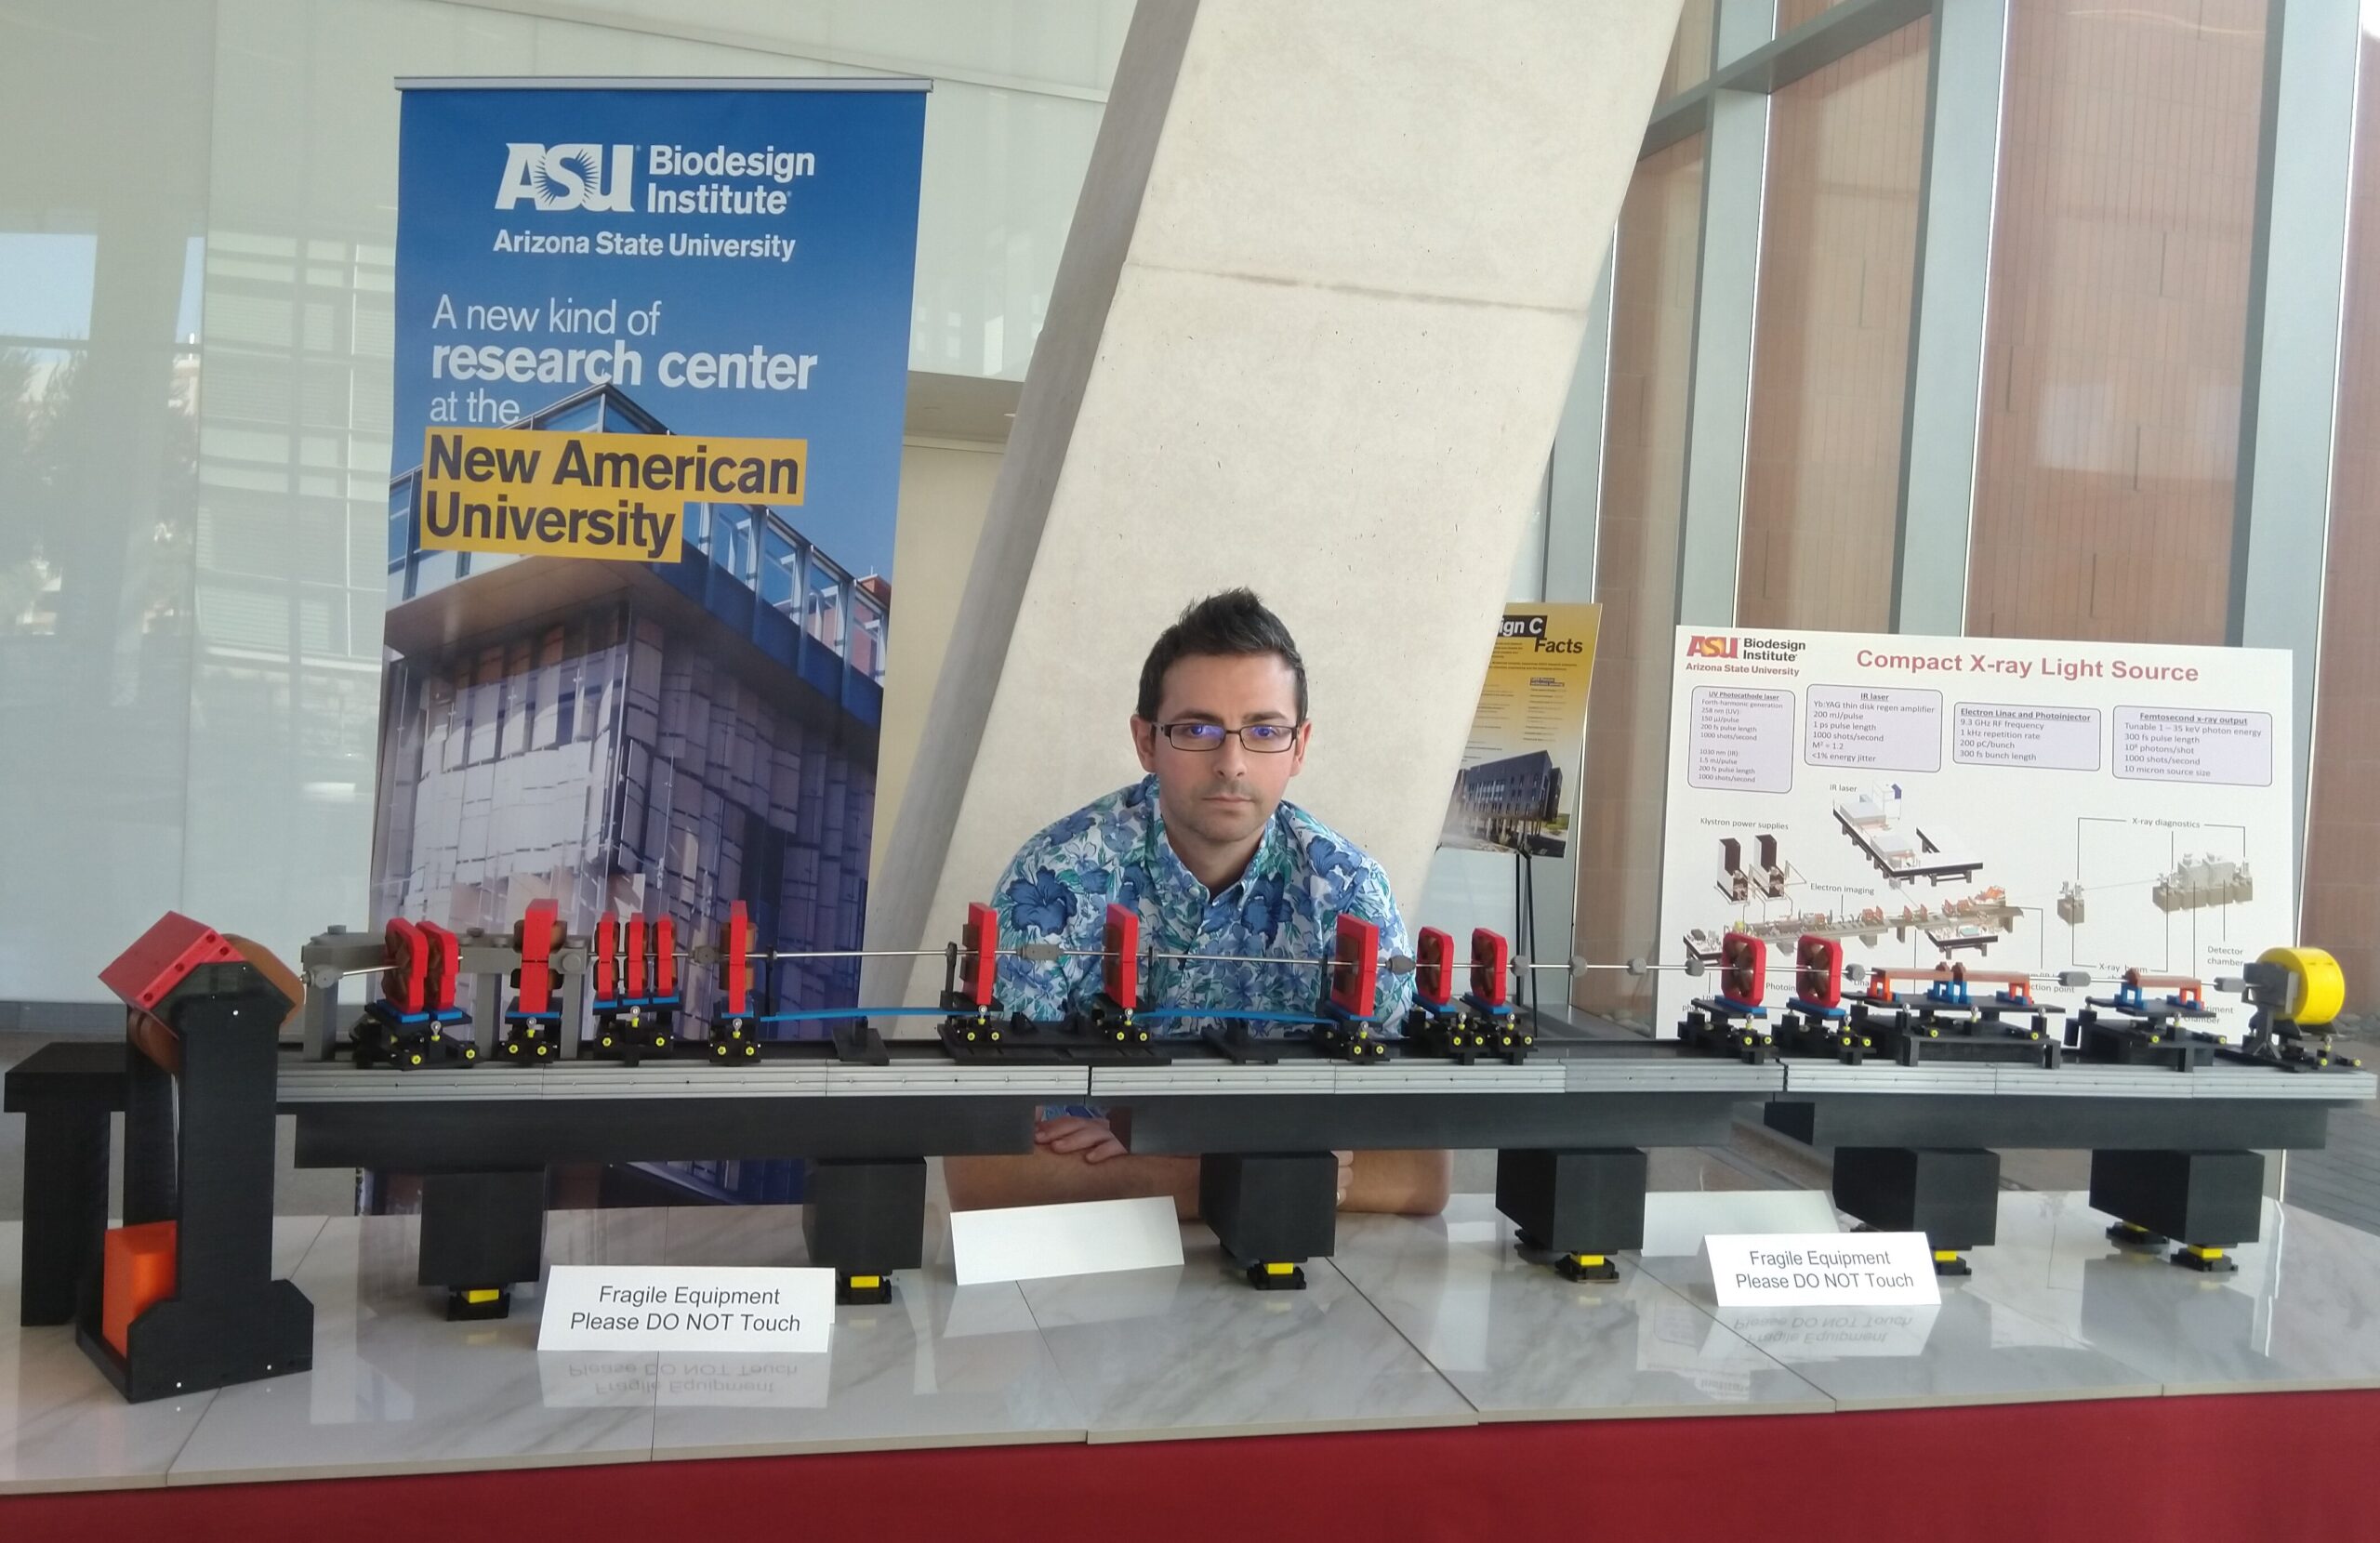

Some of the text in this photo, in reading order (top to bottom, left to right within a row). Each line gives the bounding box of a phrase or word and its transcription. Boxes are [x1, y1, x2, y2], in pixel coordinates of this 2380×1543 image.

[649, 144, 815, 183] Biodesign
[495, 143, 634, 212] ASU
[647, 183, 787, 214] Institute
[493, 230, 795, 262] Arizona State University
[432, 294, 661, 335] A new kind of
[432, 339, 816, 389] research center
[430, 388, 520, 424] at the
[429, 435, 798, 495] New American
[426, 491, 675, 557] University
[1500, 617, 1542, 636] ign C
[1535, 638, 1582, 653] Facts
[1686, 636, 1739, 658] ASU
[1744, 638, 1805, 651] Biodesign
[1743, 650, 1795, 661] Institute
[1686, 663, 1800, 677] Arizona State University
[1857, 650, 2199, 681] Compact X-ray Light Source
[1720, 692, 1763, 700] Photocathode
[1900, 705, 1936, 713] amplifier
[1961, 708, 1993, 717] Electron
[1995, 709, 2016, 718] Linac
[2036, 712, 2091, 721] Photoinjector
[1830, 712, 1863, 720] mJ/pulse
[2140, 713, 2194, 721] Femtosecond
[1853, 723, 1876, 732] length
[2004, 721, 2044, 731] frequency
[2125, 722, 2156, 731] Tunable
[2202, 726, 2231, 734] photon
[1833, 732, 1884, 742] shots/second
[1984, 731, 2022, 739] repetition
[2175, 736, 2200, 745] length
[1977, 740, 2015, 749] pC/bunch
[2140, 745, 2194, 754] photons/shot
[1831, 754, 1855, 762] energy
[1858, 754, 1876, 762] jitter
[2012, 753, 2036, 762] length
[2147, 756, 2200, 765] shots/second
[1700, 818, 1729, 826] Klystron
[1758, 822, 1788, 830] supplies
[2132, 817, 2201, 829] X-ray diagnostics
[1810, 883, 1874, 895] Electron imaging
[2208, 946, 2242, 956] Detector
[2099, 963, 2120, 972] X-ray
[2207, 957, 2243, 967] chamber
[1766, 983, 1795, 991] Photoin
[1750, 1251, 1890, 1269] Fragile Equipment
[1736, 1273, 1913, 1288] Please DO NOT Touch
[600, 1286, 780, 1308] Fragile Equipment
[570, 1312, 800, 1332] Please DO NOT Touch
